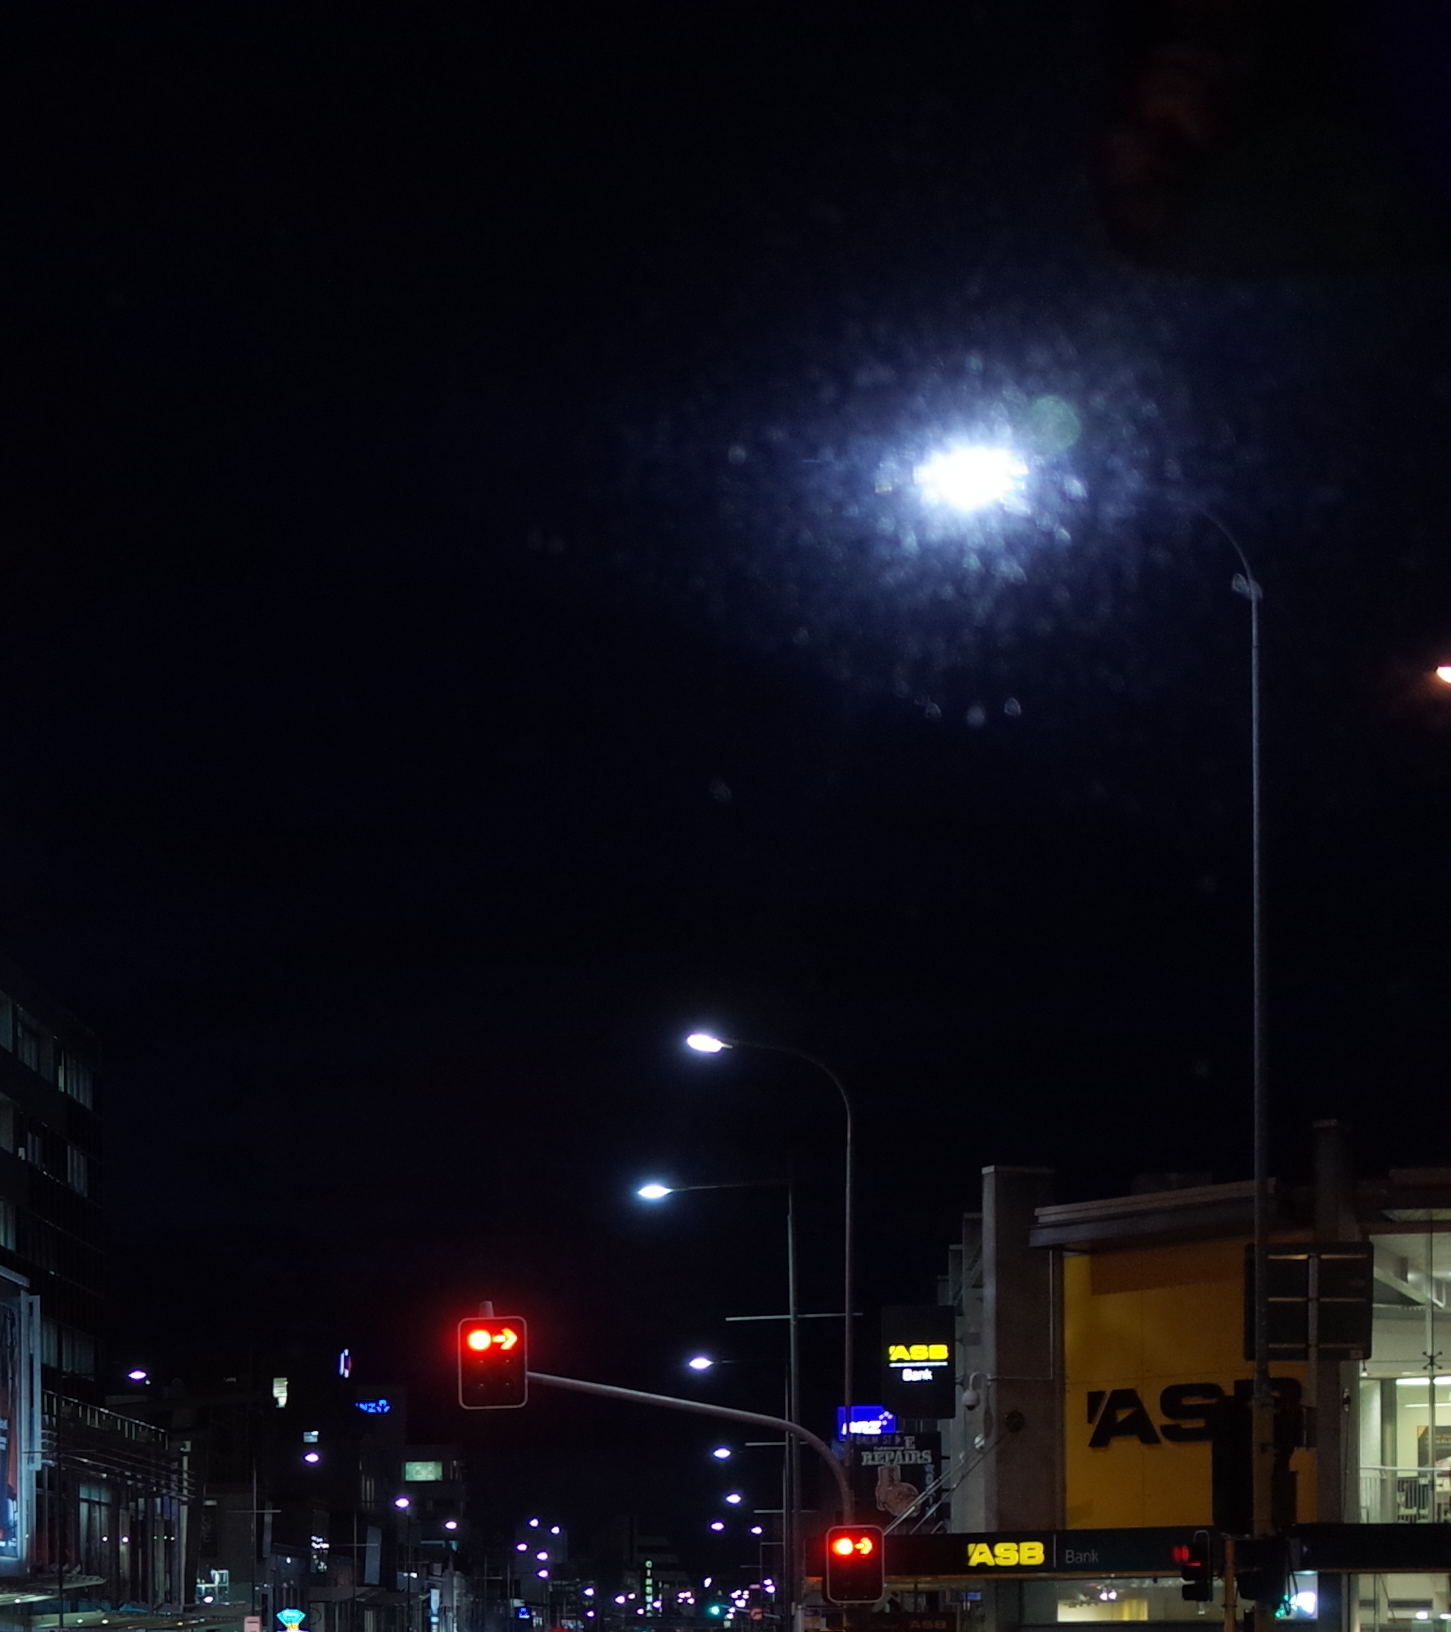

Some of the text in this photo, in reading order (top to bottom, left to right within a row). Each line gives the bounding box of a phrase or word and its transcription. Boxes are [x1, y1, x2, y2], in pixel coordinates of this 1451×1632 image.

[888, 1343, 949, 1362] ASB
[902, 1368, 933, 1382] Bank
[861, 1450, 932, 1466] REPAIRS
[967, 1541, 1099, 1567] ASB Bank
